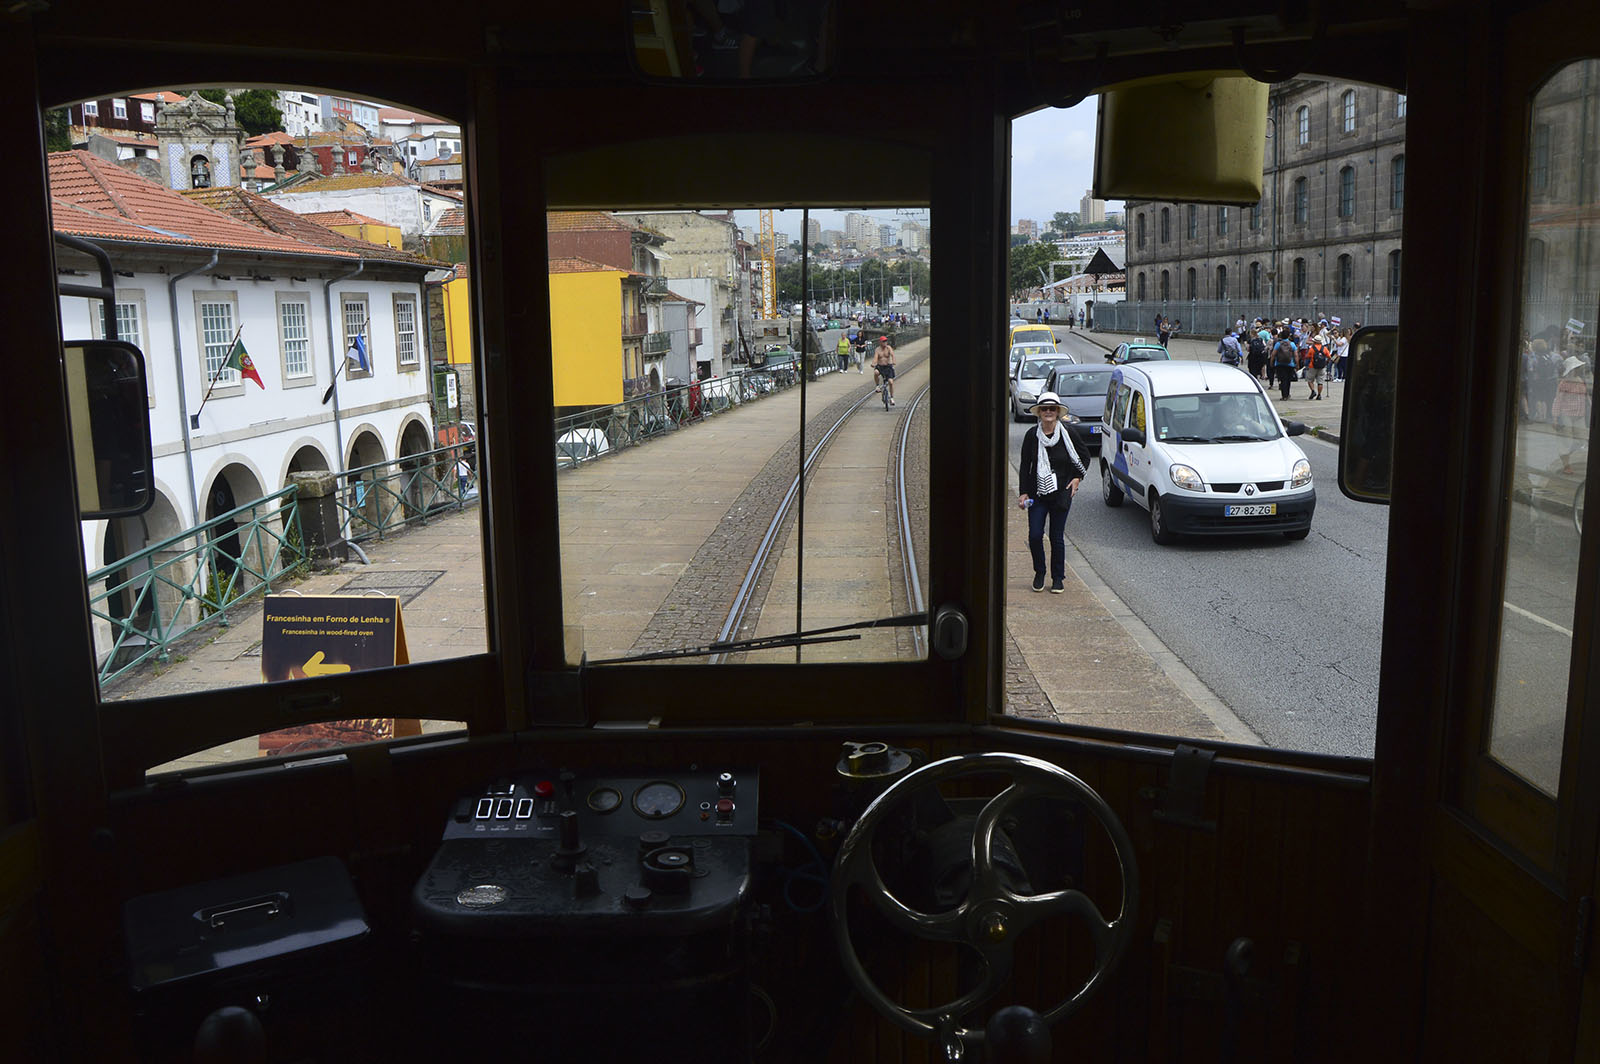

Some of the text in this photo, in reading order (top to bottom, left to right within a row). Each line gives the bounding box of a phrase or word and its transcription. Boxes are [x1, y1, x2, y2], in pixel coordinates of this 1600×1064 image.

[266, 614, 311, 623] Francesinha
[325, 615, 348, 623] Forno
[349, 615, 359, 624] de
[360, 615, 384, 624] Lenha
[281, 628, 318, 636] Francesinha
